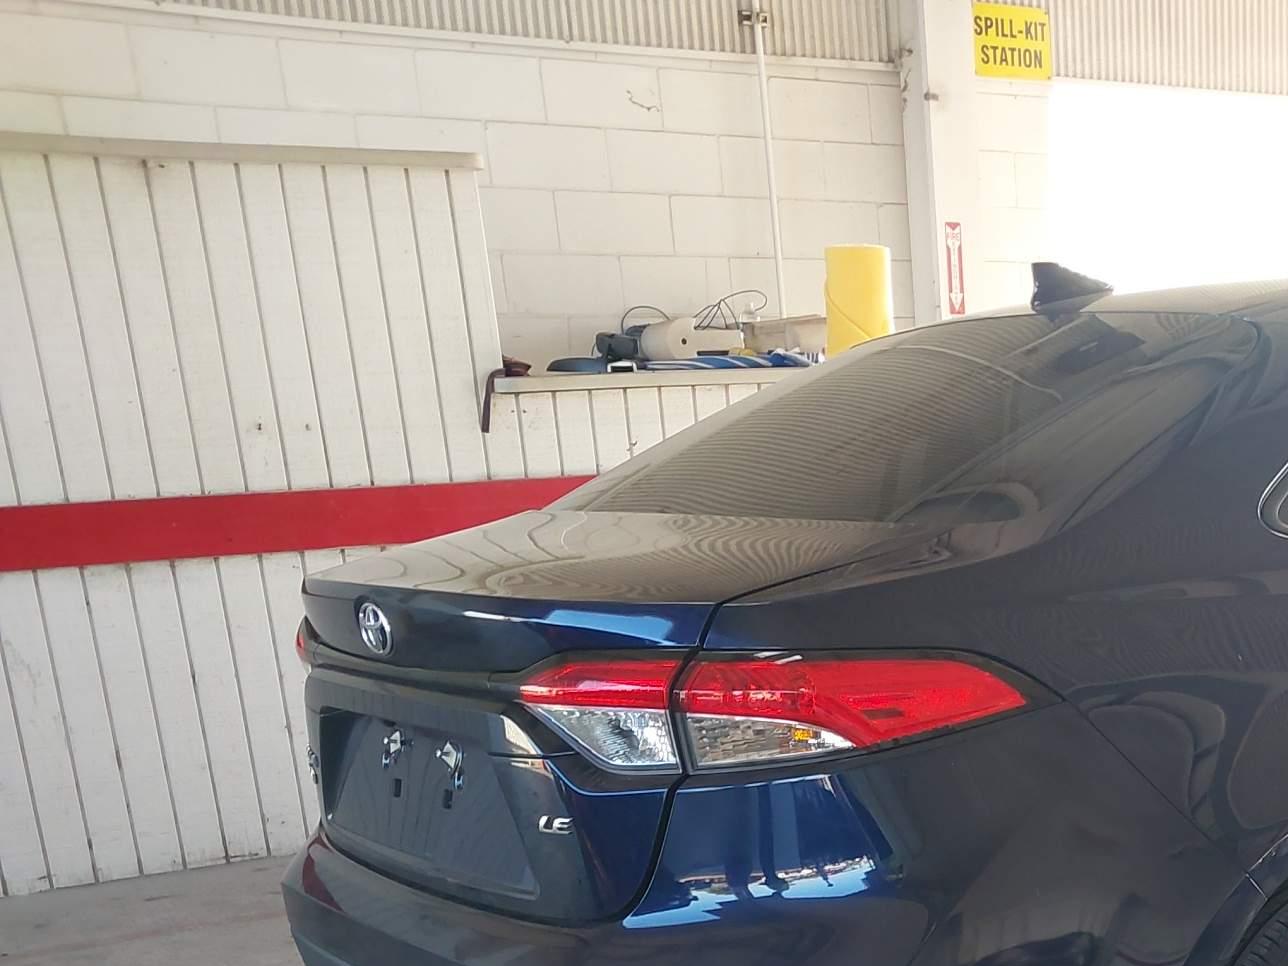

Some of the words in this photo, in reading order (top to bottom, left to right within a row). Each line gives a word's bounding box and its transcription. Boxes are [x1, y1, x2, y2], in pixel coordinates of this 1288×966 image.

[973, 15, 1047, 42] SPILL-KIT
[980, 44, 1043, 69] STATION
[538, 815, 574, 835] LE
